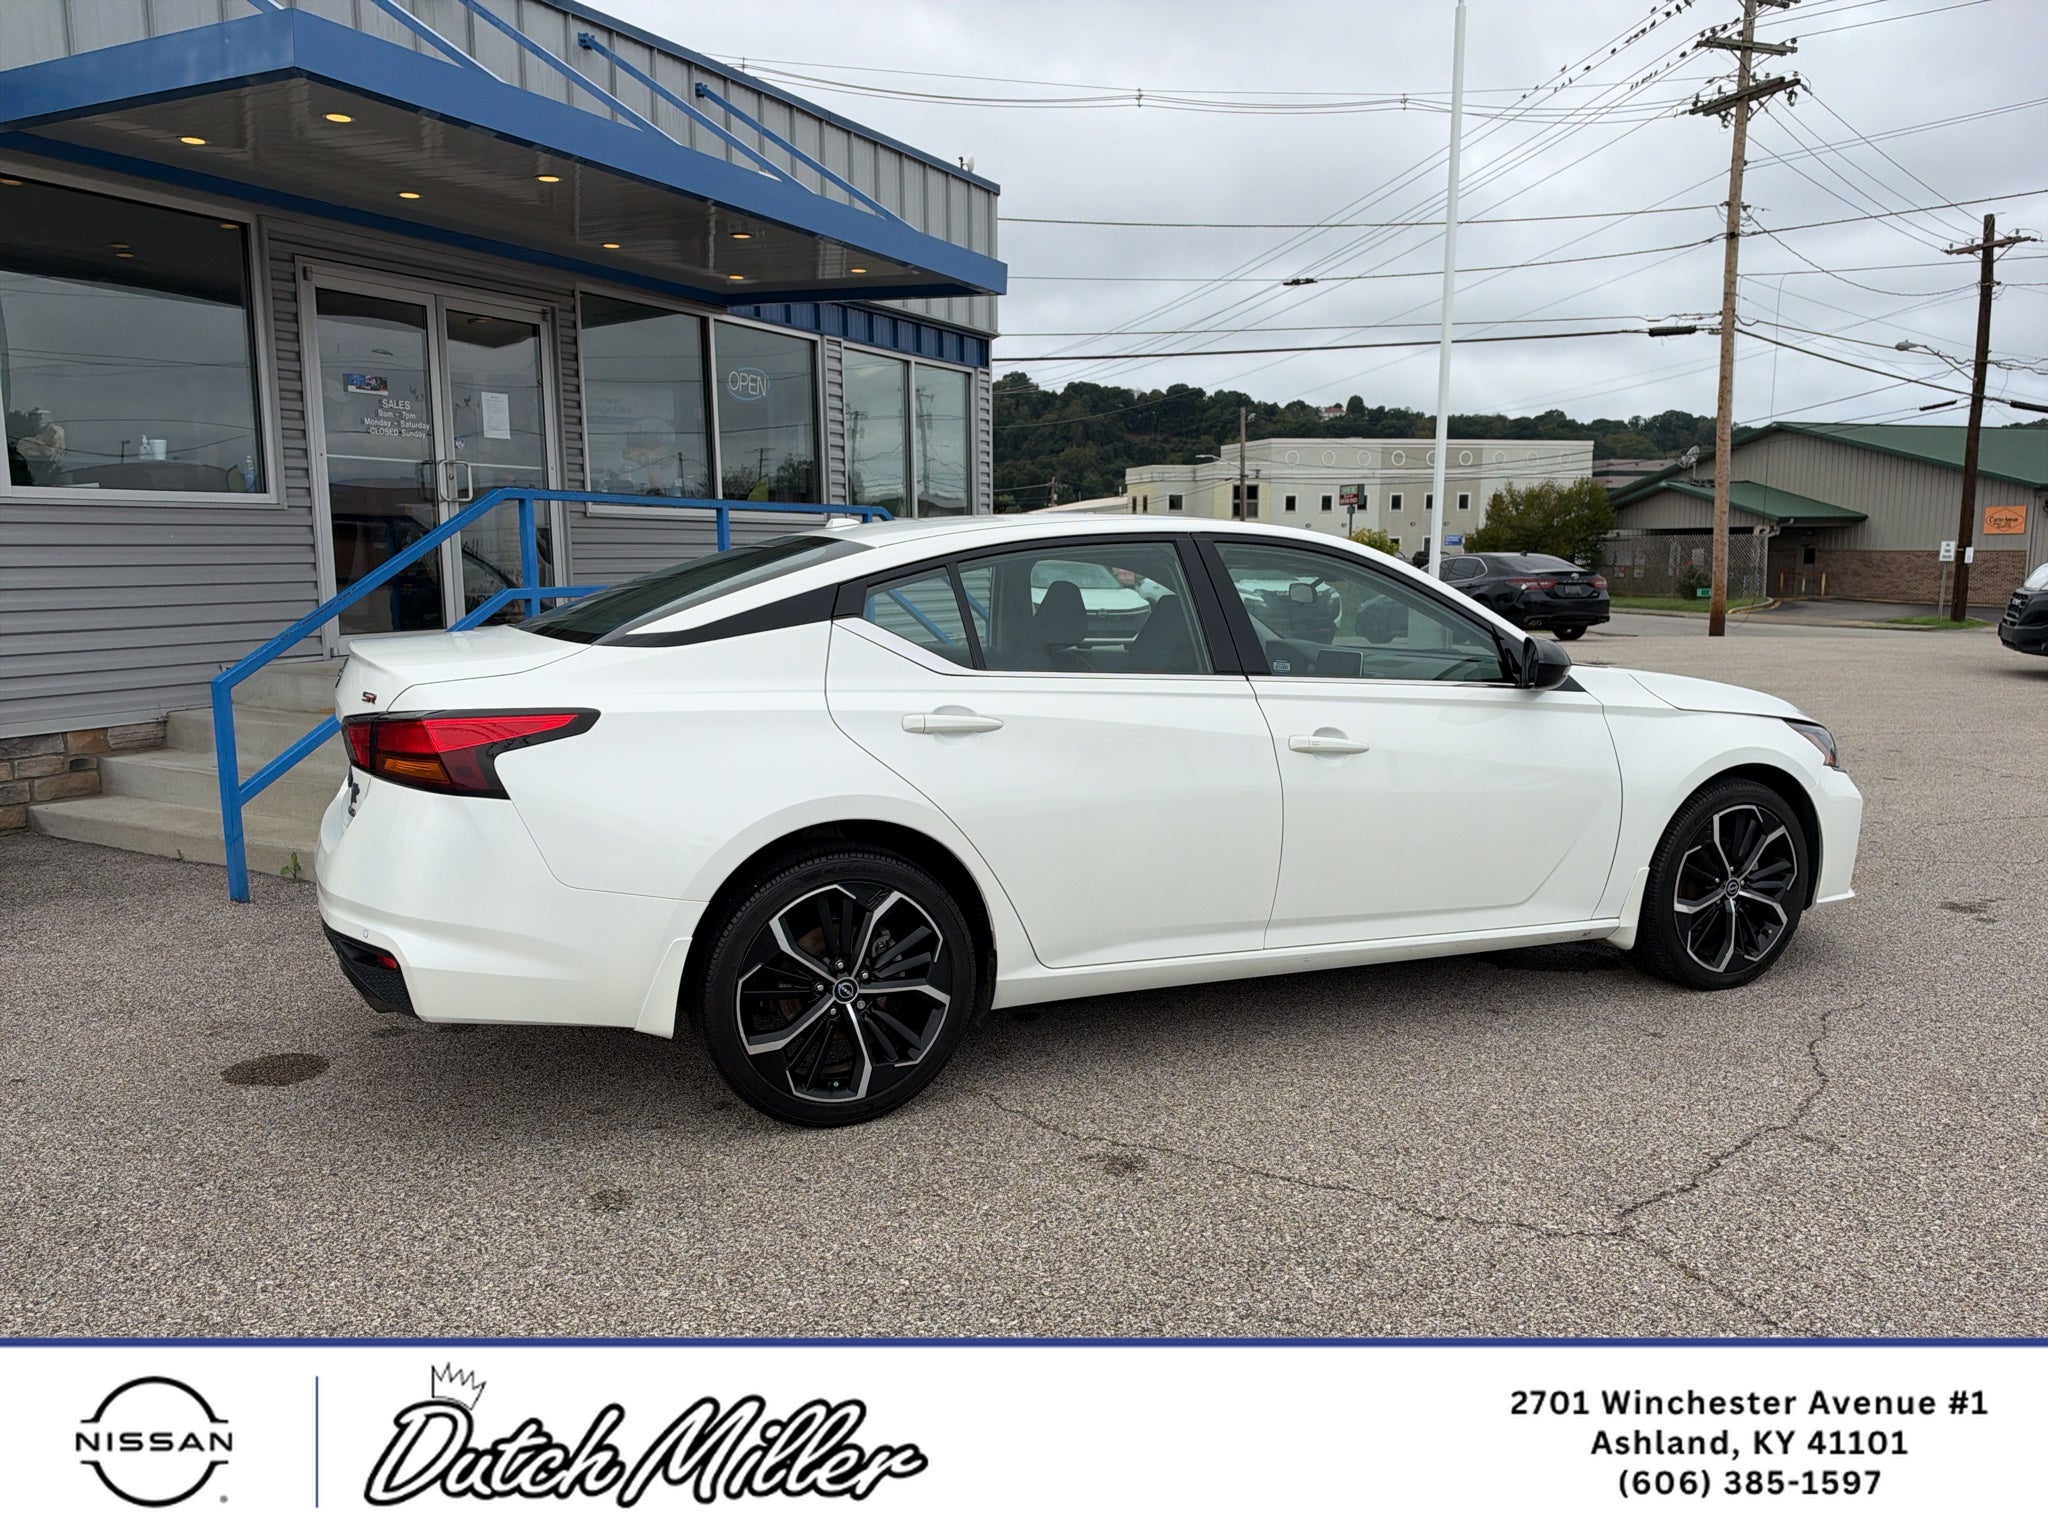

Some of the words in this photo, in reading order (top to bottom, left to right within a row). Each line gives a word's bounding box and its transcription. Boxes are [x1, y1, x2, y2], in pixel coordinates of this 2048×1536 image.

[728, 370, 767, 397] OPEN
[382, 398, 411, 410] SALES
[377, 409, 394, 418] 9am
[401, 411, 416, 420] 7pm
[364, 416, 392, 428] Monday
[400, 419, 430, 431] Saturday
[369, 426, 399, 436] CLOSED
[401, 428, 427, 440] Sunday
[361, 691, 378, 705] SR
